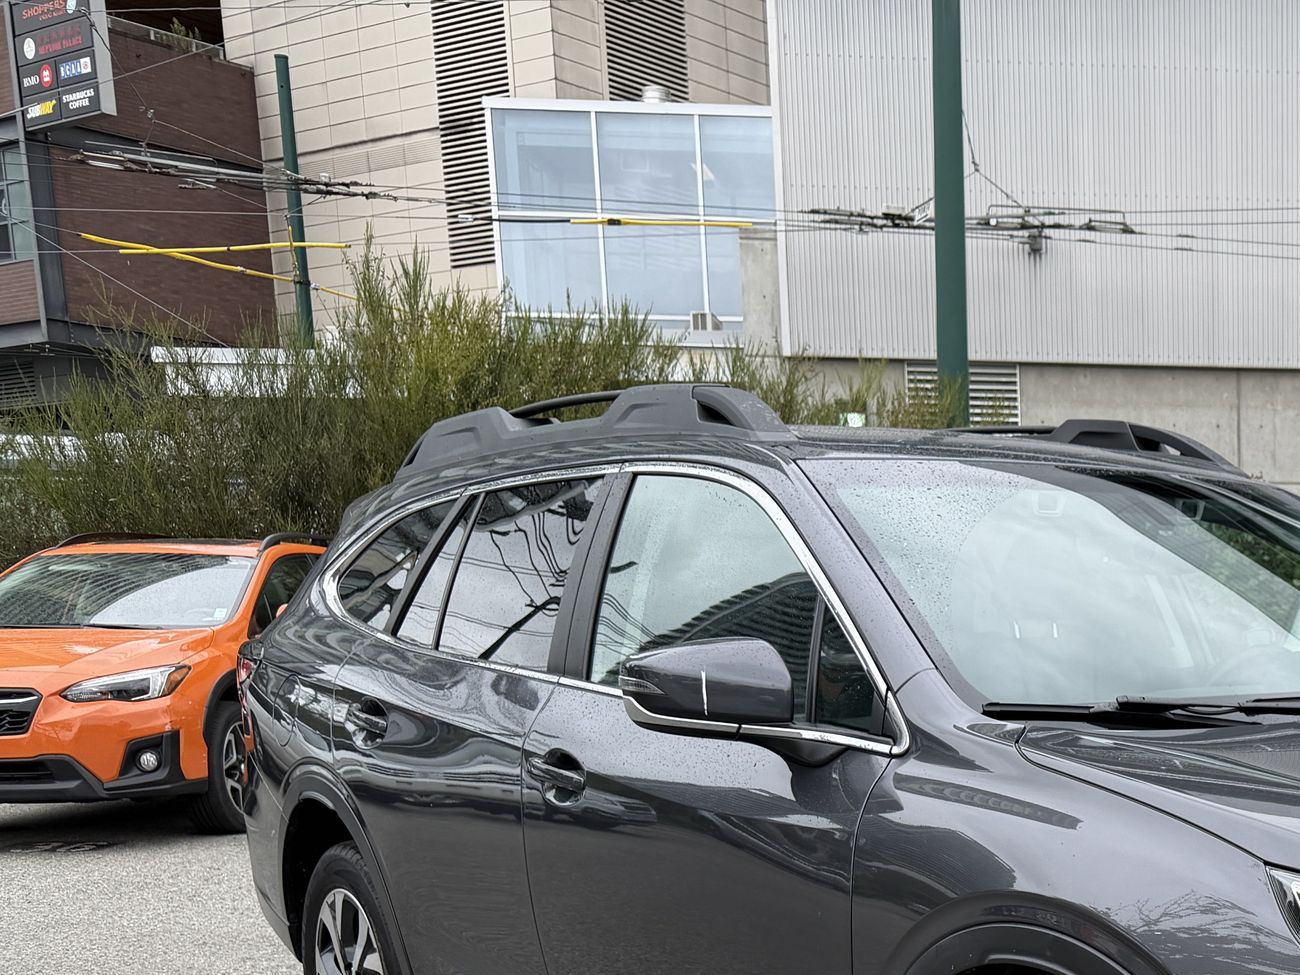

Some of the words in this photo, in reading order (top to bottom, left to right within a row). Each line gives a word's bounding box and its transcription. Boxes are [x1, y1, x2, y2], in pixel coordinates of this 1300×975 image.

[22, 0, 66, 19] SHOPPERS
[23, 75, 39, 87] BMO
[63, 88, 94, 103] STARBUCKS
[27, 99, 57, 119] SUBWAY
[69, 98, 90, 110] COFFEE
